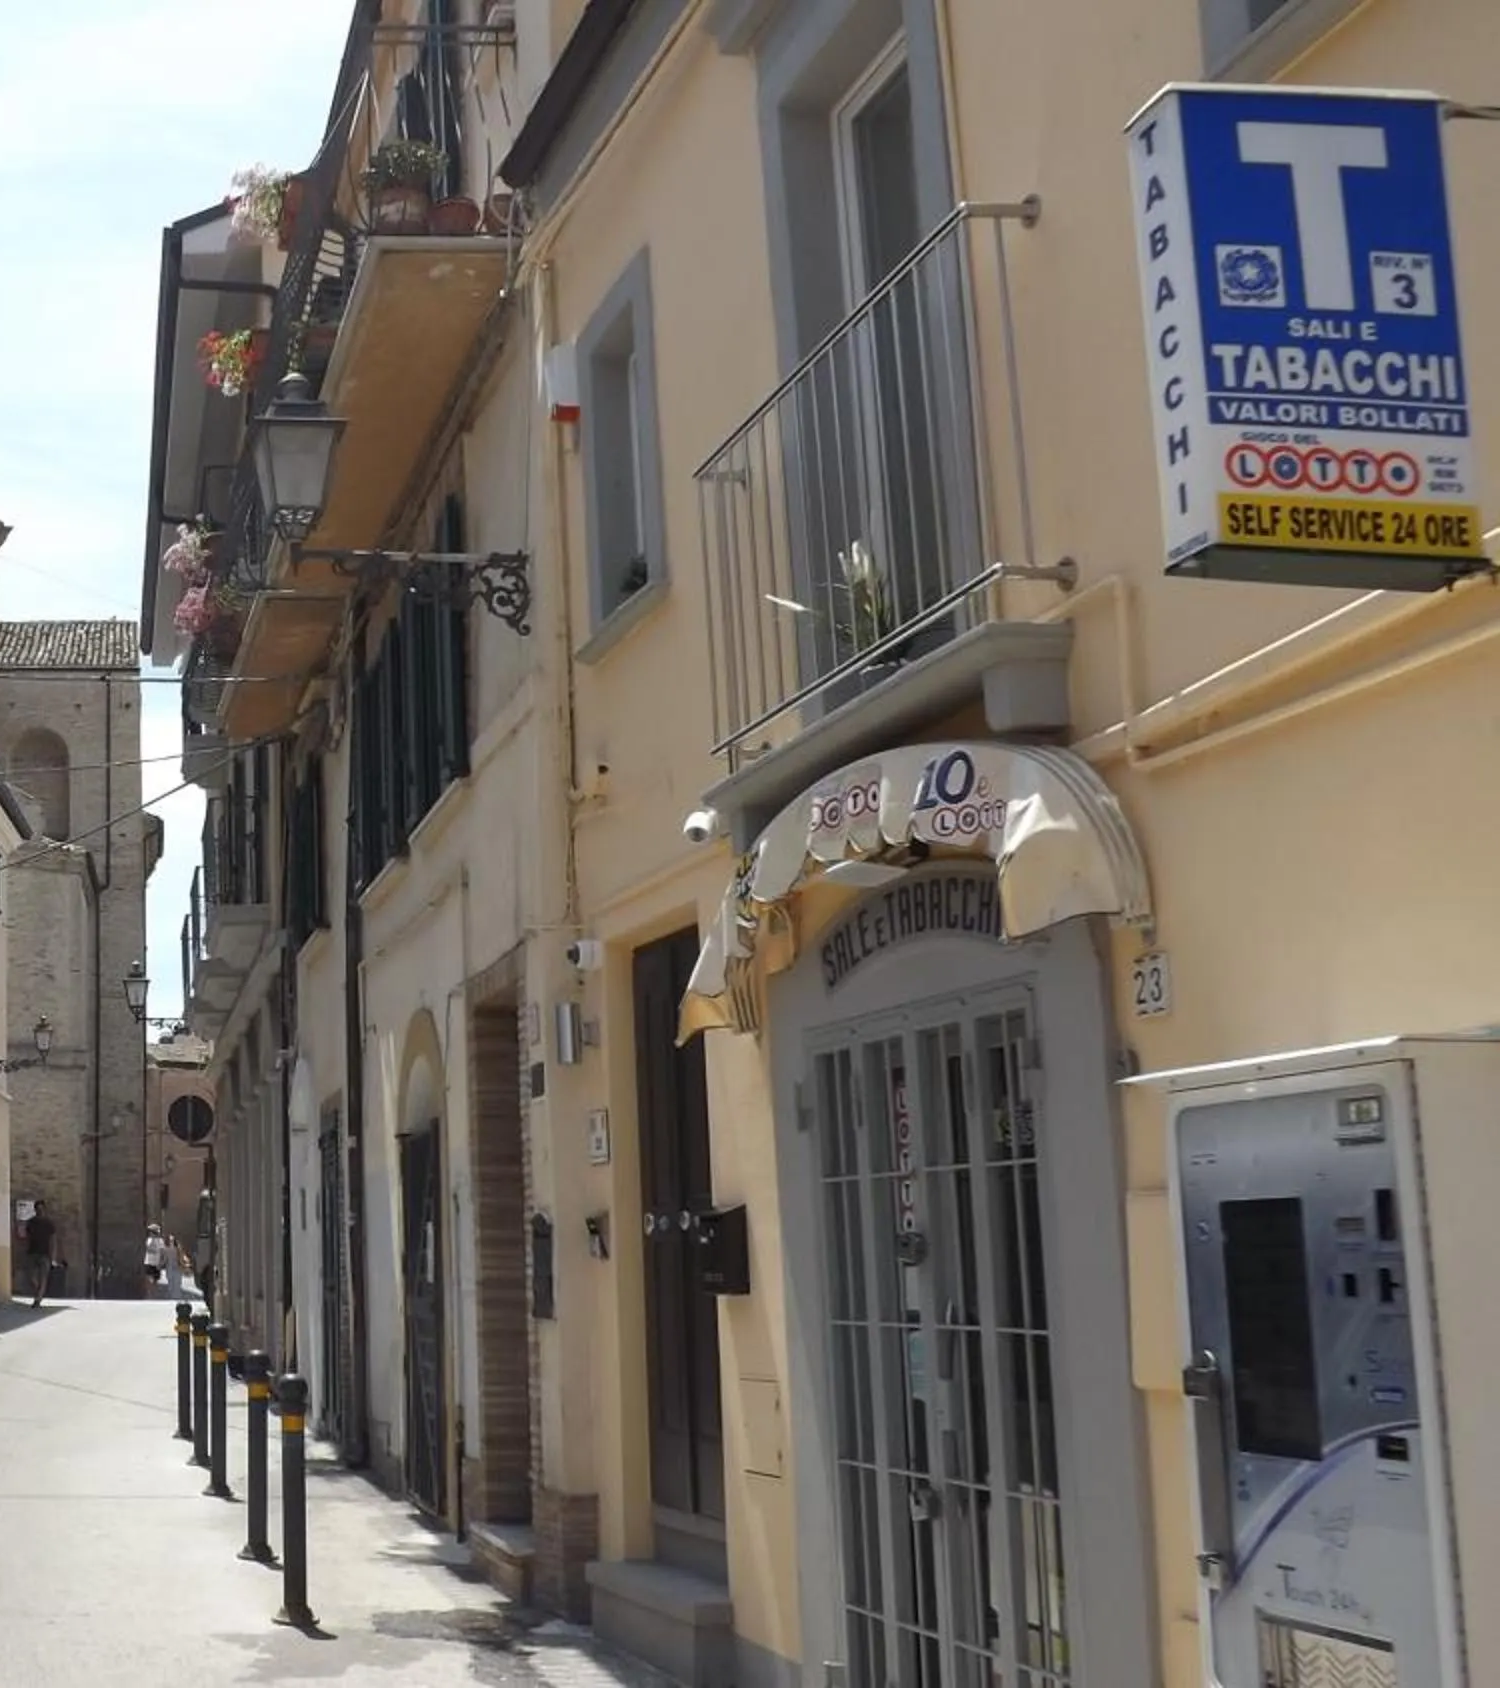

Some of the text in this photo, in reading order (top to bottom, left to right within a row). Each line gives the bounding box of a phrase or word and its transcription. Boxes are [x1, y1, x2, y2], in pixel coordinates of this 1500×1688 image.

[1236, 121, 1388, 311] T
[1391, 273, 1418, 309] 3
[1138, 121, 1190, 515] TABACCHI
[1288, 318, 1378, 341] SALI E
[1211, 343, 1457, 399] TABACCHI
[1218, 401, 1462, 432] VALORI BOLLATI
[1225, 443, 1420, 496] LOTTO
[1227, 503, 1471, 547] SELF SERVICE 24 ORE
[916, 750, 975, 811] 10
[932, 800, 1007, 837] LOTT
[822, 908, 874, 988] SALE
[1135, 966, 1165, 1005] 23
